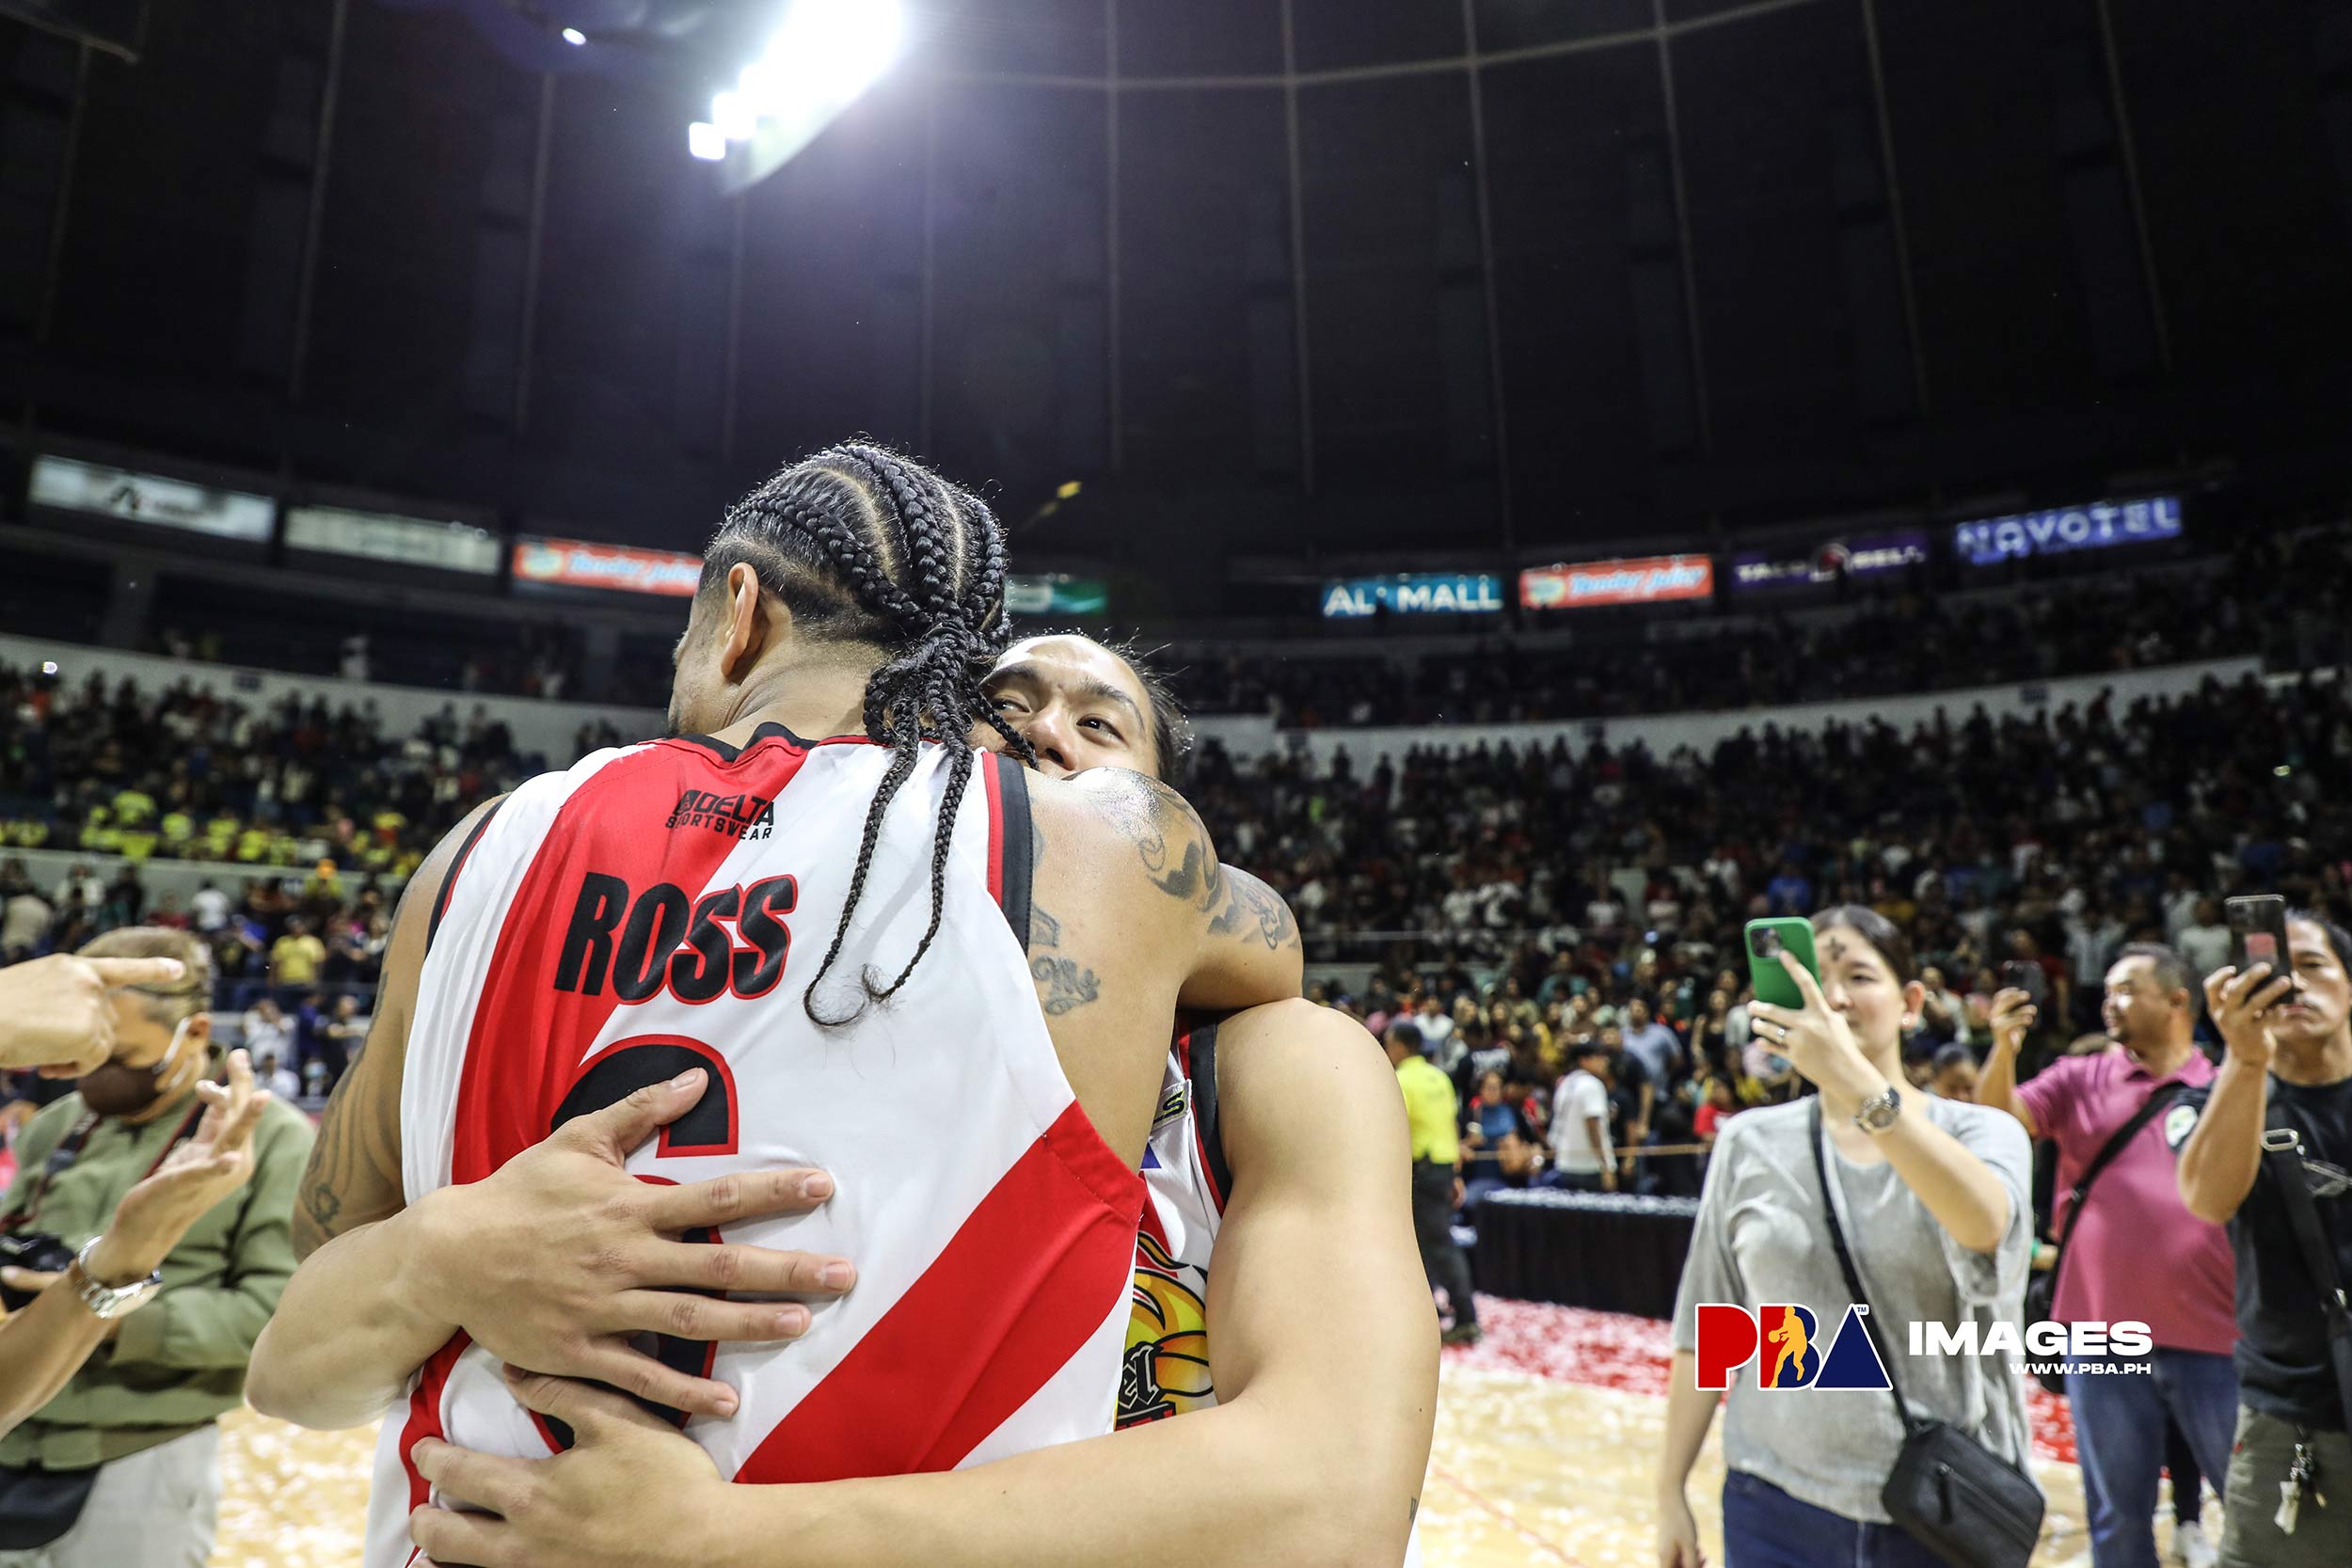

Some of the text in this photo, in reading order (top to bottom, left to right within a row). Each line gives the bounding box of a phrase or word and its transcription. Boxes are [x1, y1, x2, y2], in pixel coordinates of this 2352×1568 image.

[1957, 498, 2180, 553] NOVOTEL
[1324, 583, 1504, 616] AL MALL
[693, 792, 774, 827] DELTA
[553, 872, 798, 1005] ROSS
